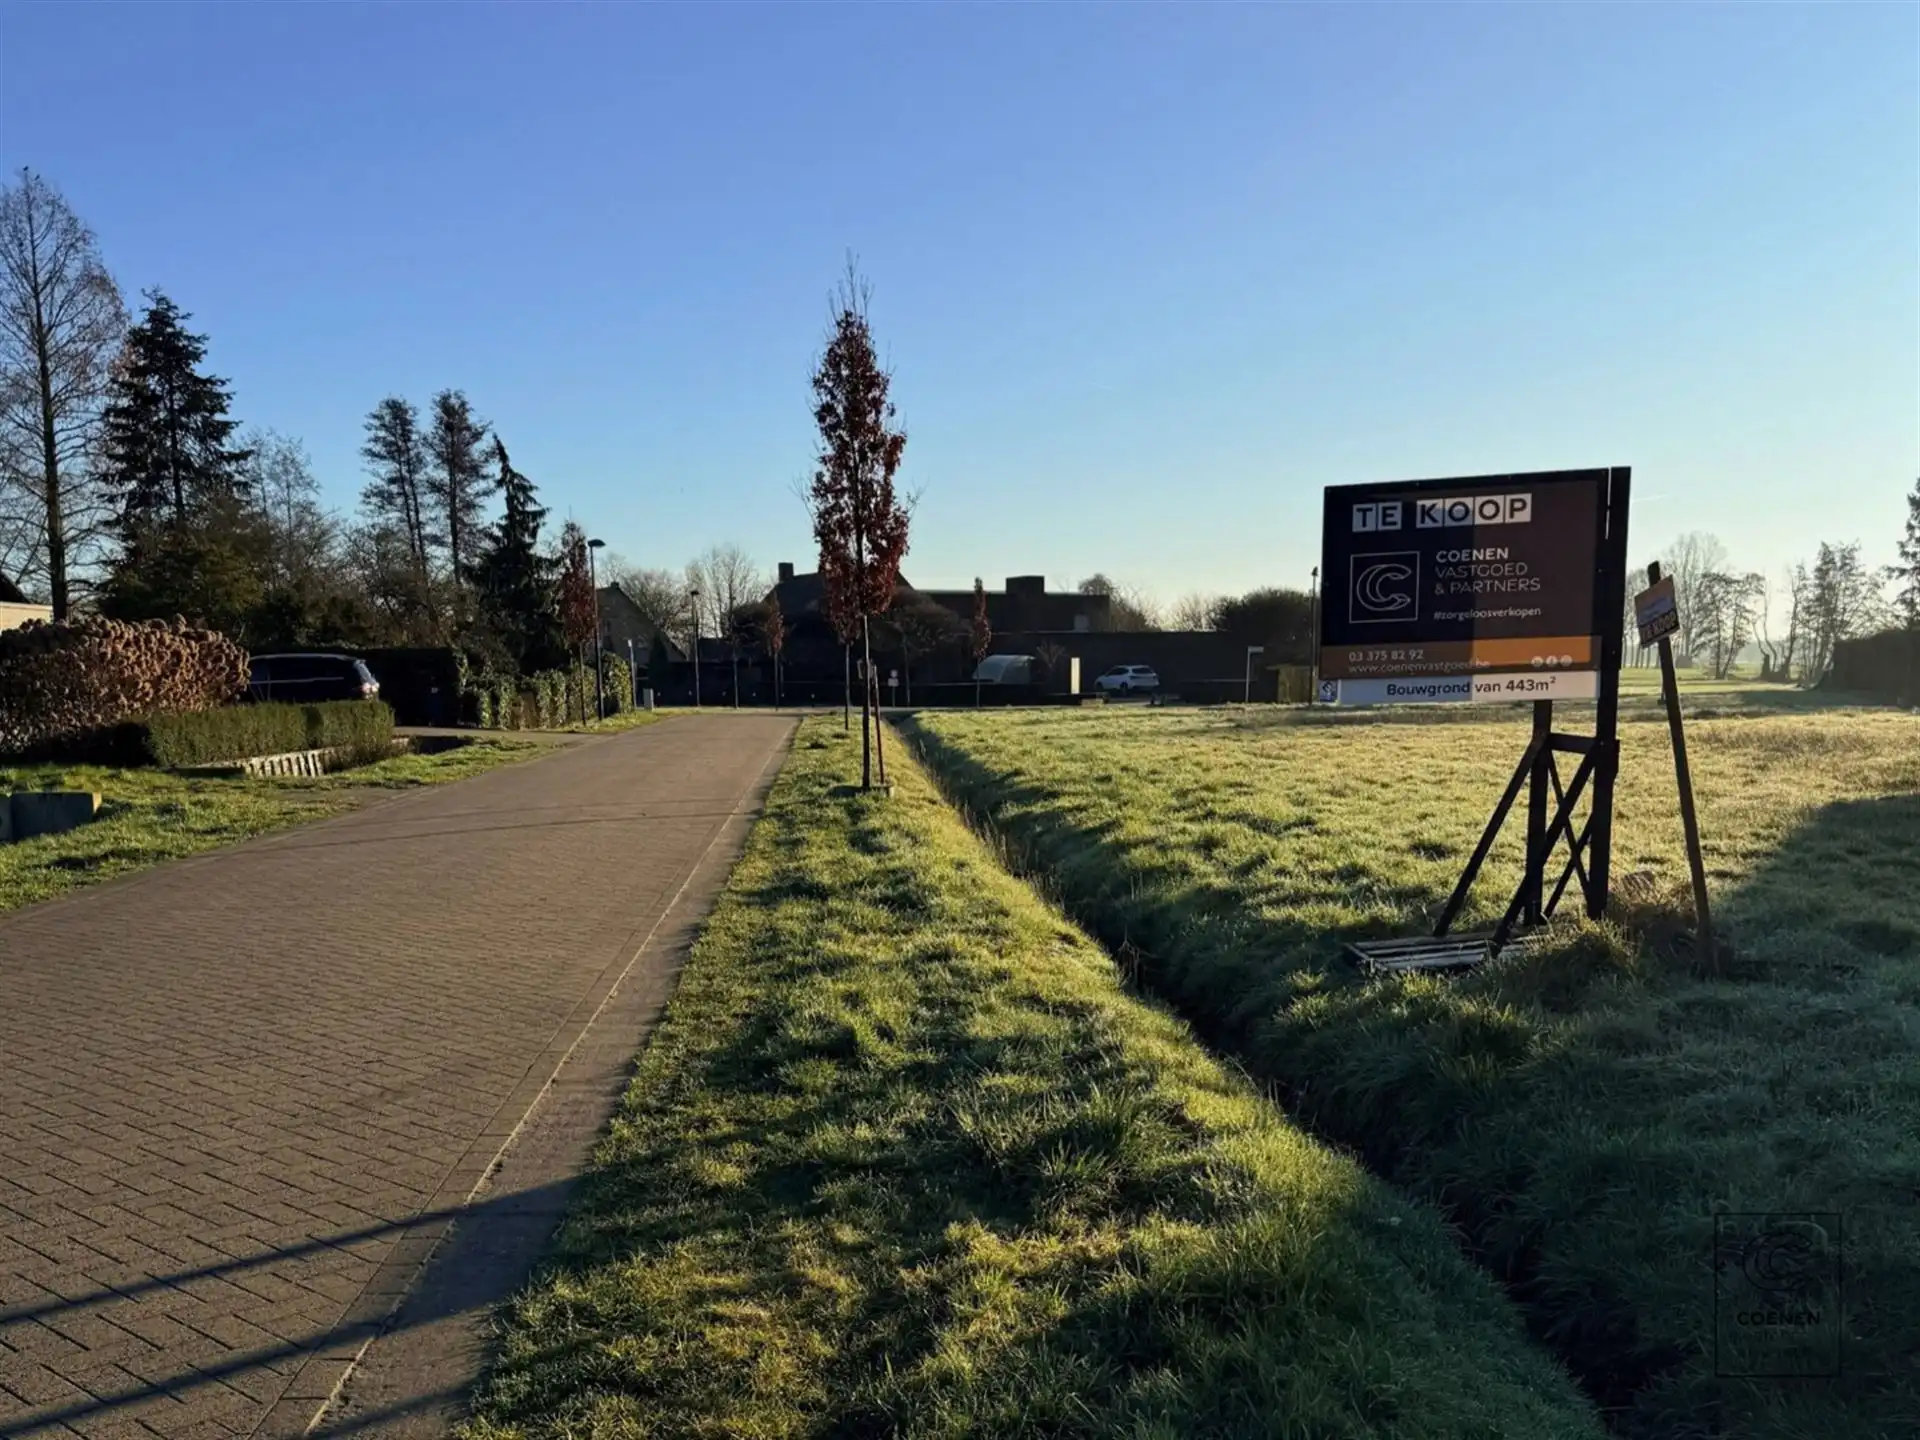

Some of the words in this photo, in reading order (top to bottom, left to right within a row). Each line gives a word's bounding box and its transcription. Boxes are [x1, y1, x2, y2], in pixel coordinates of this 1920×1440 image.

[1356, 506, 1397, 528] TE
[1420, 498, 1527, 524] KOOP
[1436, 547, 1509, 563] COENEN
[1435, 562, 1528, 579] VASTGOED
[1434, 582, 1444, 595] &
[1450, 577, 1541, 595] PARTNERS
[1433, 606, 1542, 621] #zorgeloosverkopen
[1349, 651, 1363, 662] 03
[1366, 650, 1387, 661] 375
[1391, 650, 1405, 660] 82
[1408, 649, 1424, 660] 92
[1387, 681, 1471, 697] Bouwgrond
[1475, 682, 1500, 693] van
